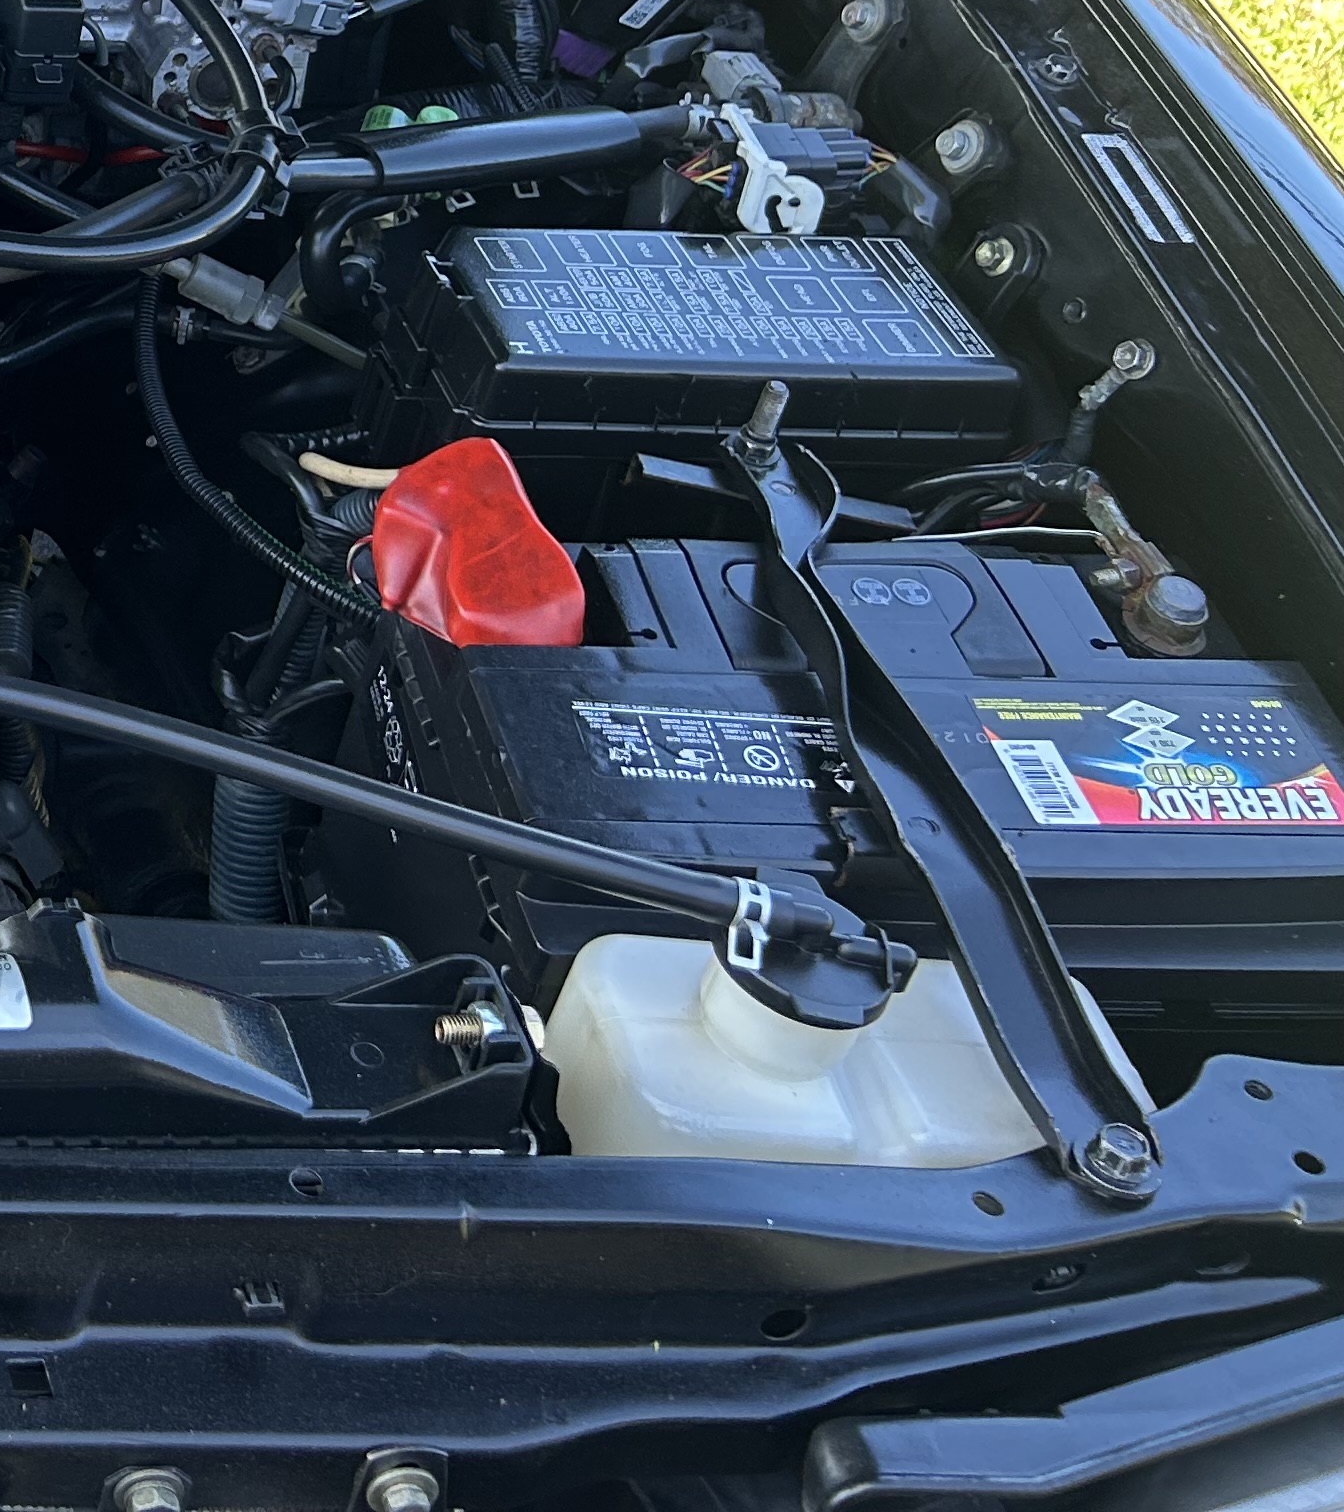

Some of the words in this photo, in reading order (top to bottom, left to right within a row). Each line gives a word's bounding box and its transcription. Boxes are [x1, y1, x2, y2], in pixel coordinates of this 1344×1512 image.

[525, 320, 552, 351] TOYOTA
[752, 730, 771, 740] NO
[619, 765, 707, 781] POISON
[711, 771, 816, 788] DANGER/
[1143, 763, 1237, 787] GOLD
[1136, 787, 1340, 822] EVEREADY
